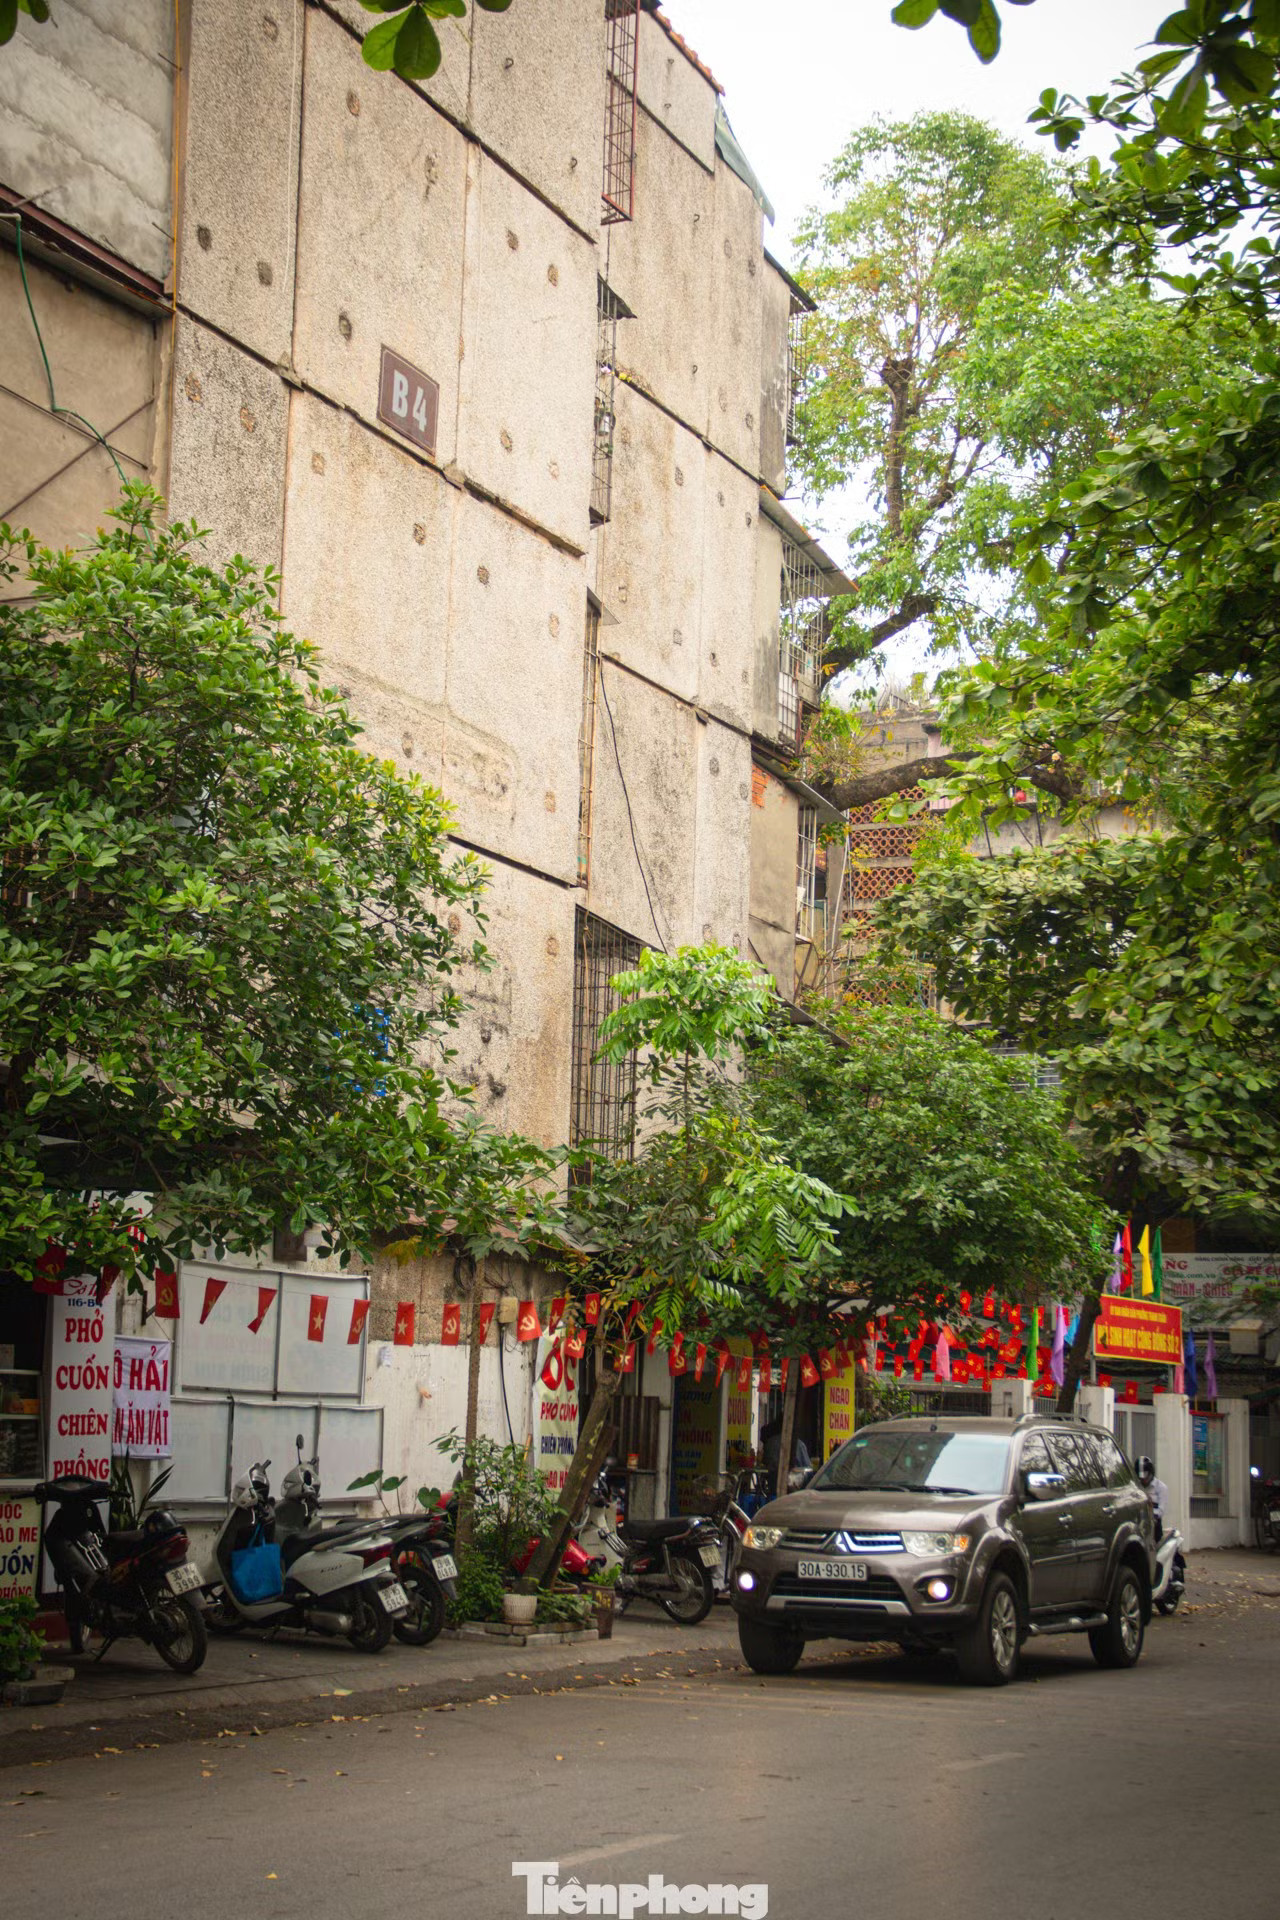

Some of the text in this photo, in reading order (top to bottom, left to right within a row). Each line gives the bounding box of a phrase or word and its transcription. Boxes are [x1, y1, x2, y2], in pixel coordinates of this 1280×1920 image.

[65, 1308, 105, 1343] PHỞ
[56, 1353, 110, 1390] CUỐN
[129, 1345, 169, 1391] HẢI
[829, 1386, 850, 1405] NGAO
[58, 1407, 109, 1436] CHIÊN
[19, 1527, 38, 1543] ME
[800, 1562, 865, 1579] 30A-930.15
